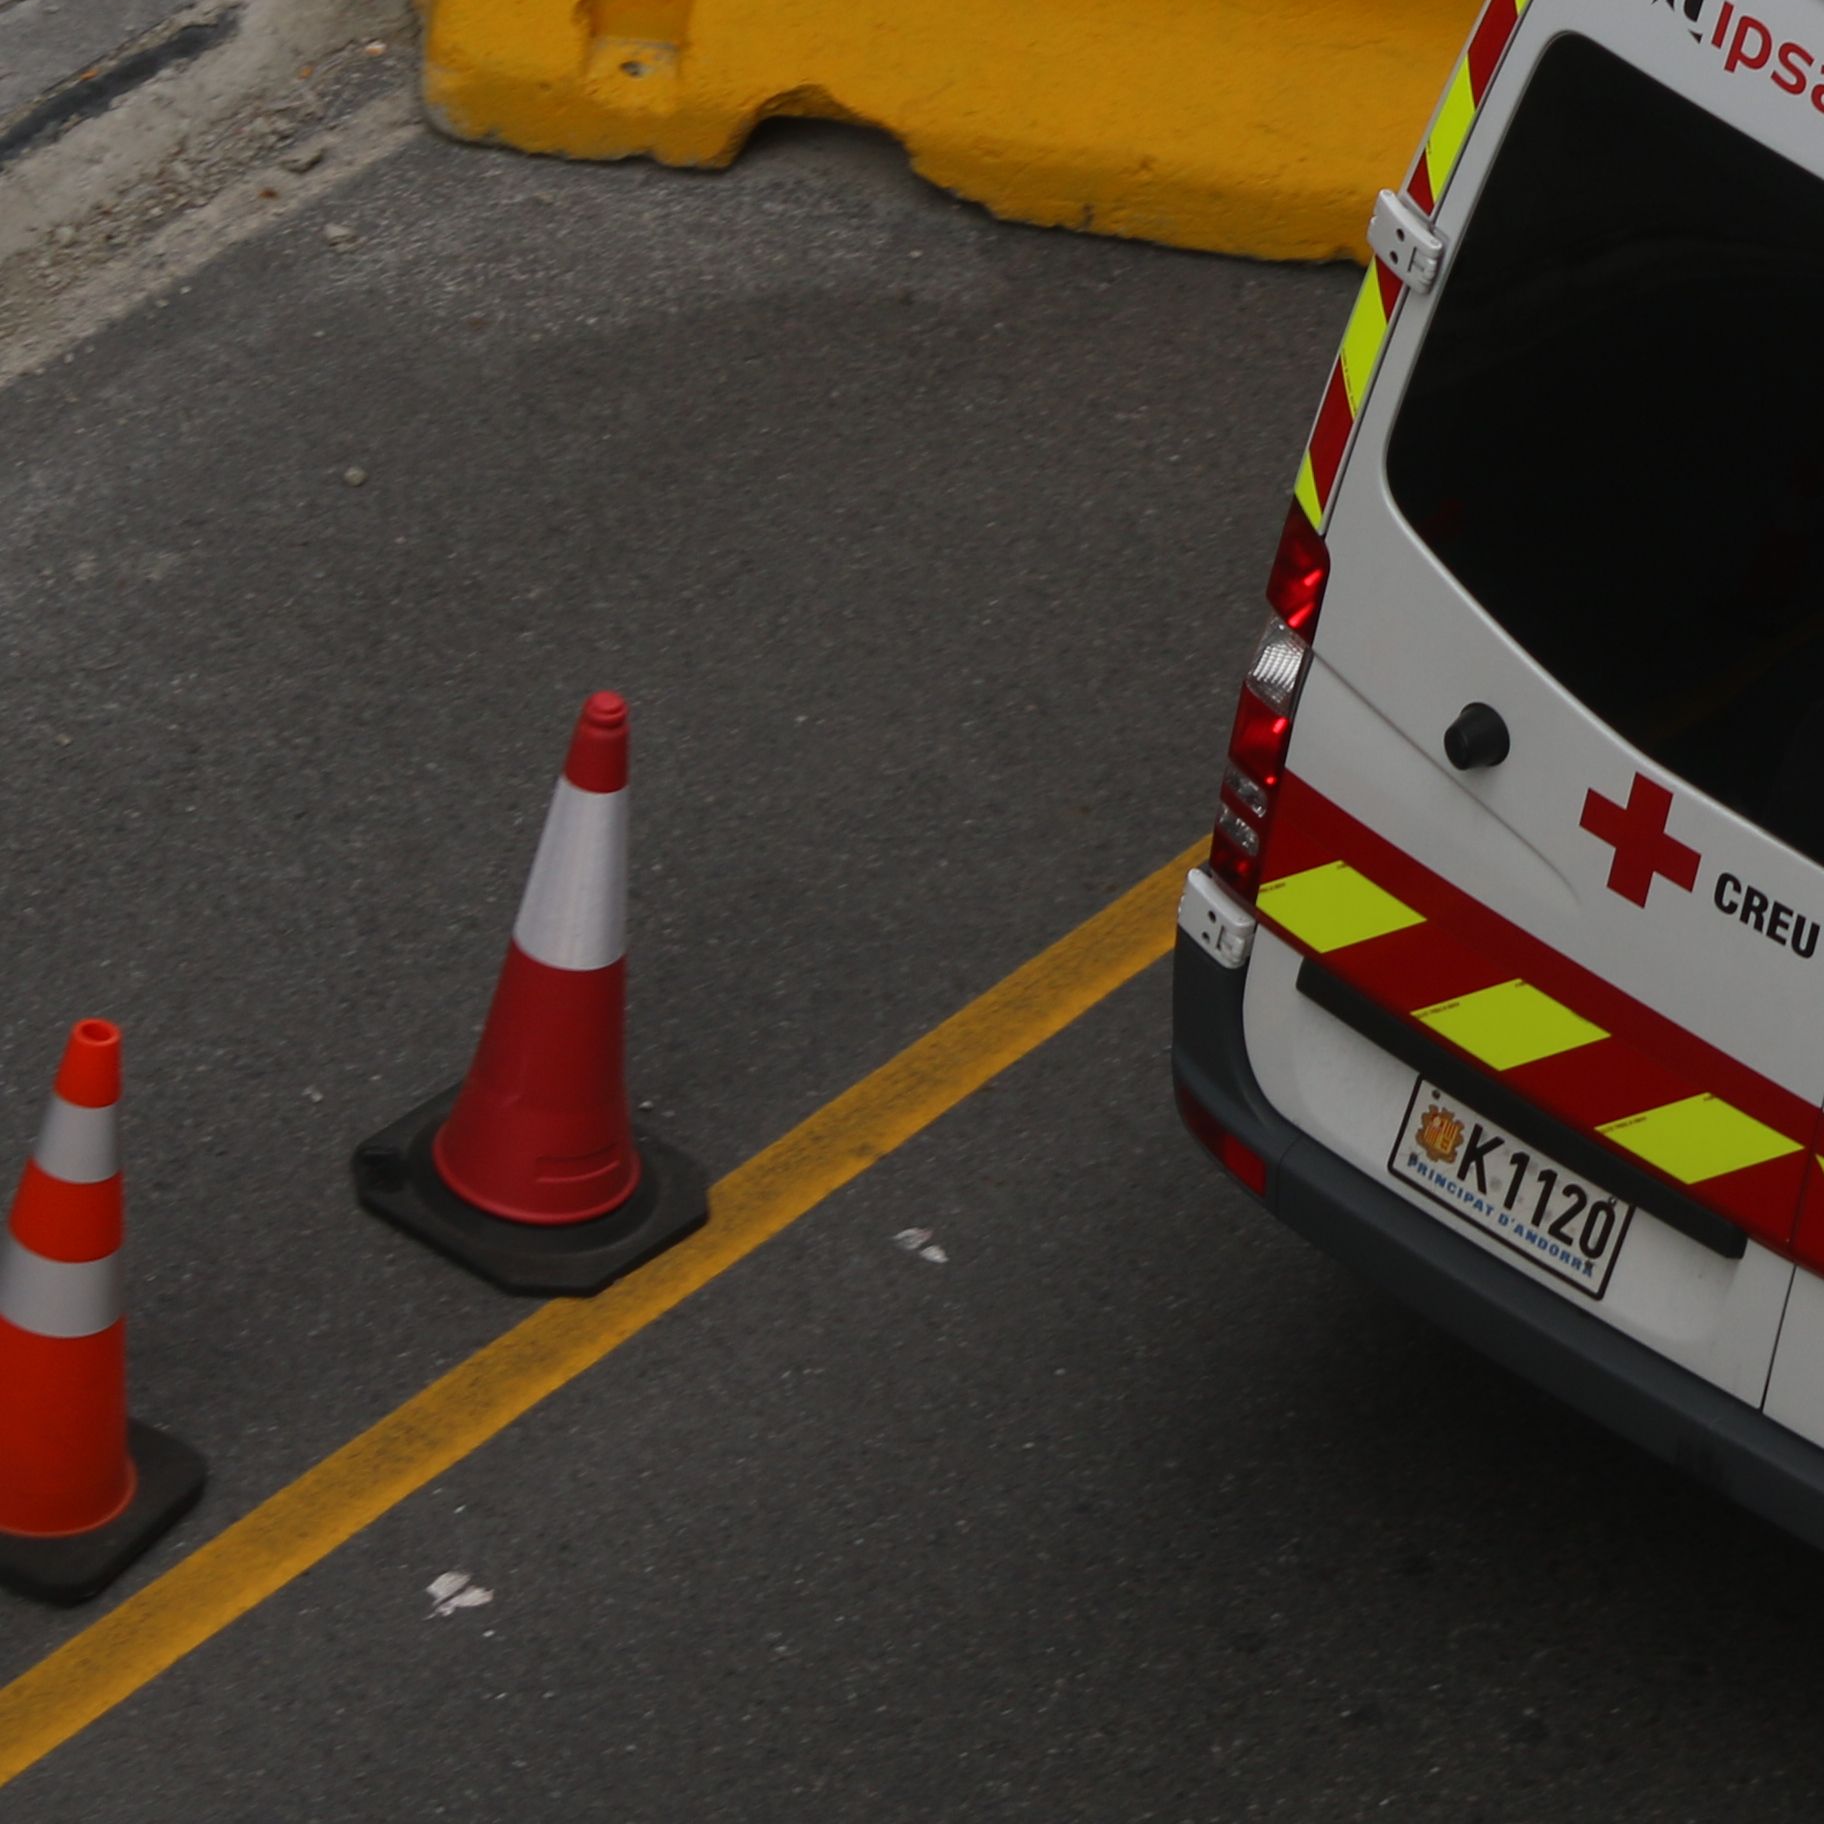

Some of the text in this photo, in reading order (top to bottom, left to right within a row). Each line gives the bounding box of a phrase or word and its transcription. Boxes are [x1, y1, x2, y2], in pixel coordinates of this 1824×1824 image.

[1712, 871, 1822, 962] CREU
[1407, 1152, 1594, 1277] PRINCIPAT D'ANDORRA
[1457, 1123, 1616, 1259] K1120
